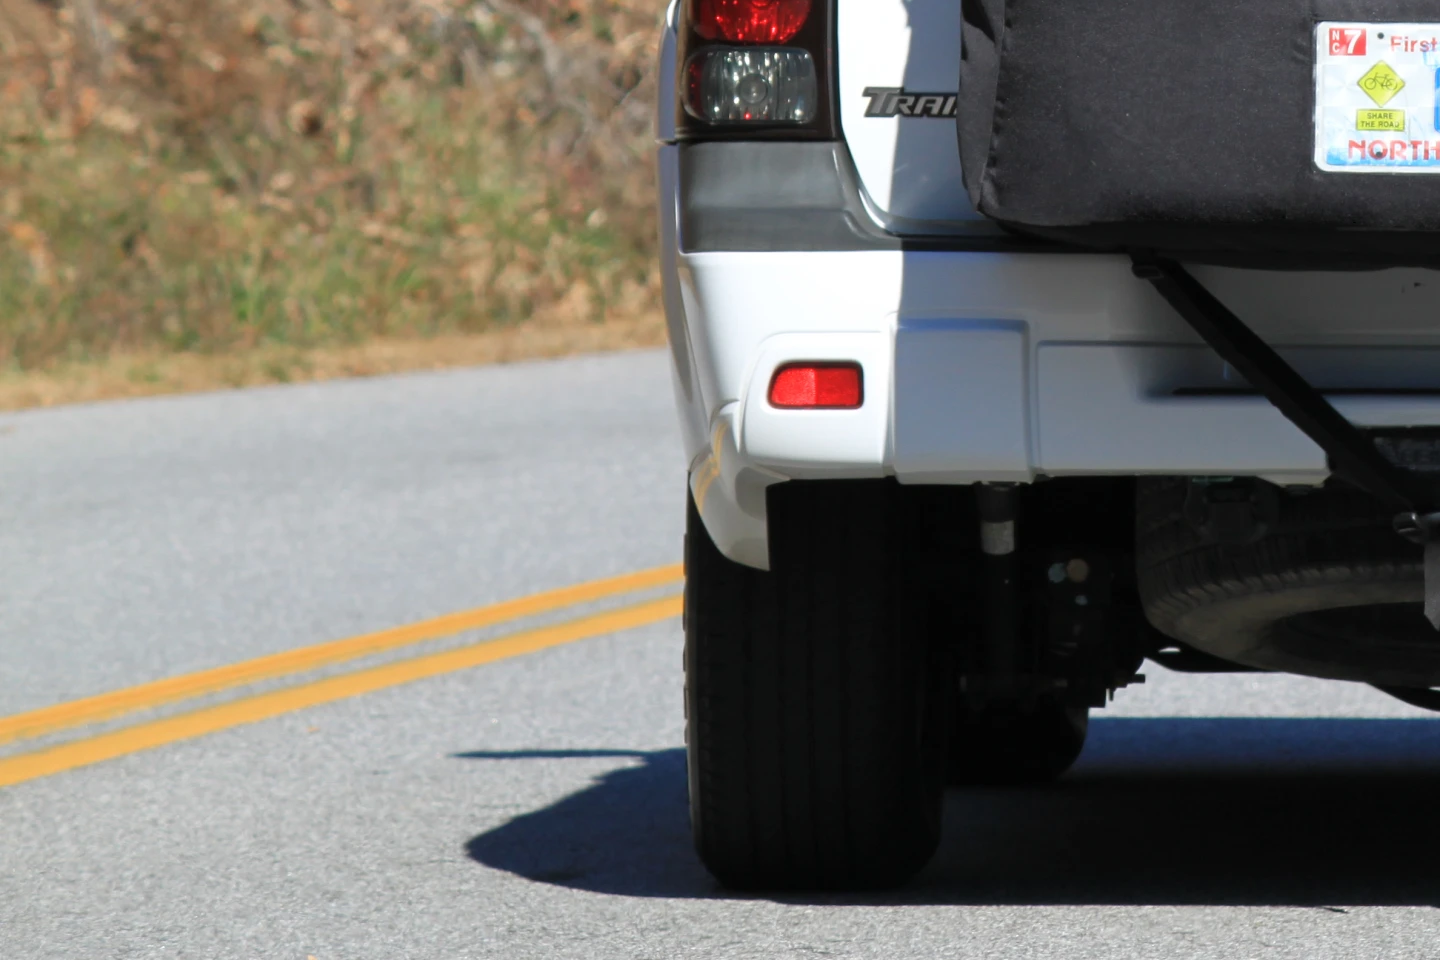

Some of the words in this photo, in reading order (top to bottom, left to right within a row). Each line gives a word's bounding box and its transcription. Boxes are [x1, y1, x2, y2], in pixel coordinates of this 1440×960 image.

[1343, 29, 1362, 54] 7
[1390, 35, 1438, 53] First
[862, 86, 958, 117] TRAI
[1360, 120, 1375, 128] THE
[1378, 121, 1400, 129] ROAD
[1367, 112, 1393, 120] SHARE
[1348, 140, 1440, 161] NORTH
